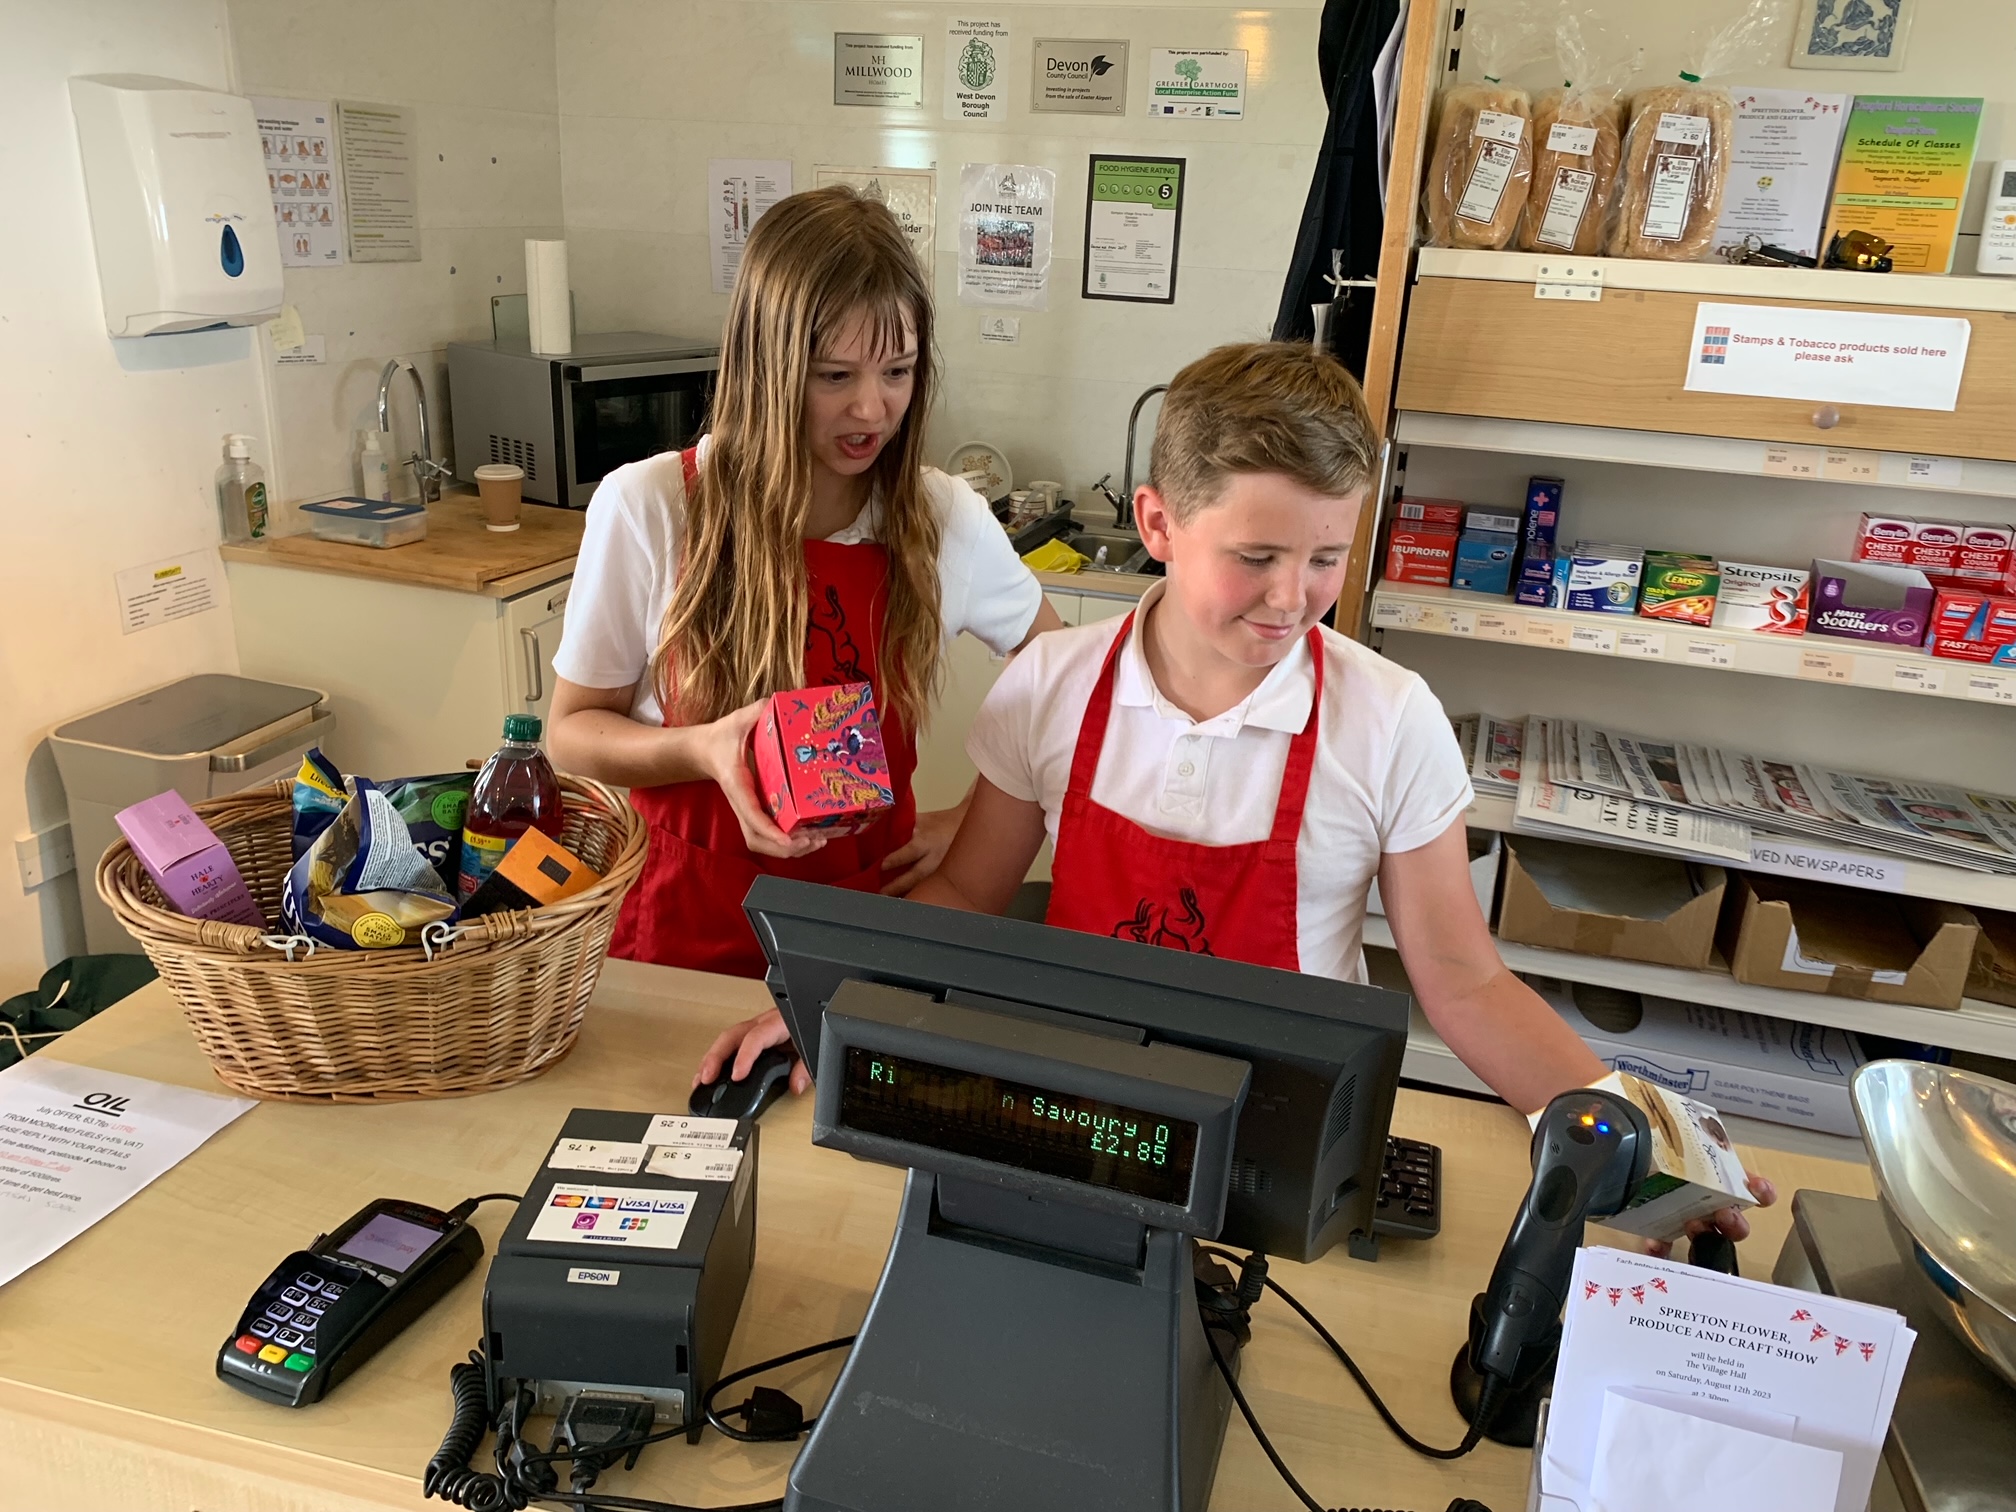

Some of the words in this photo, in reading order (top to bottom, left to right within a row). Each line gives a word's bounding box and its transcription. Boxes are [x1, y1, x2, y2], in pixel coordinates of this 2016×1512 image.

[970, 21, 989, 29] project
[973, 29, 994, 37] funding
[1047, 57, 1088, 72] Devon
[845, 66, 913, 78] MILLWOOD
[1046, 72, 1066, 80] County
[1067, 72, 1088, 80] Council
[1045, 86, 1065, 94] Investing
[1194, 81, 1238, 89] DARTMOOR
[956, 92, 973, 100] West
[1172, 89, 1201, 97] Enterprise
[962, 101, 989, 110] Borough
[963, 110, 988, 118] Council
[1857, 138, 1902, 147] Schedule
[1906, 139, 1919, 148] Of
[1924, 140, 1961, 149] Classes
[1494, 151, 1513, 161] Bakery
[1099, 164, 1119, 172] FOOD
[1120, 165, 1149, 174] HYGIENE
[1150, 166, 1175, 175] RATING
[1671, 164, 1691, 172] Bakery
[1570, 177, 1589, 187] Bakery
[1162, 185, 1170, 198] 5
[970, 203, 992, 213] JOIN
[995, 204, 1012, 215] THE
[1015, 205, 1043, 215] TEAM
[1732, 333, 1774, 346] Stamps
[1777, 337, 1785, 346] &
[1789, 337, 1837, 350] Tobacco
[1839, 342, 1890, 354] products
[1893, 345, 1918, 355] sold
[1921, 347, 1946, 358] here
[1794, 351, 1831, 363] please
[1834, 354, 1854, 363] ask
[1873, 526, 1909, 538] Benylin
[1920, 531, 1956, 544] Benylin
[1865, 542, 1909, 553] CHESTY
[1968, 536, 2004, 548] Benylin
[1392, 544, 1450, 558] IBUPROFEN
[1867, 550, 1903, 559] COUGHS
[1912, 547, 1957, 558] CHESTY
[1960, 551, 2005, 562] CHESTY
[1915, 554, 1951, 563] COUGHS
[1963, 559, 1999, 568] COUGHS
[1665, 575, 1703, 586] LEMSIP
[1724, 566, 1802, 584] Strepsils
[1723, 578, 1761, 589] Original
[1946, 602, 1976, 613] Rennie
[1833, 609, 1867, 619] HALLS
[1817, 610, 1889, 633] Soothers
[1940, 640, 1969, 650] FAST
[1663, 816, 1679, 838] kill
[1784, 852, 1885, 881] NEWSPAPERS
[190, 864, 214, 882] HALE
[191, 874, 224, 897] HEARTY
[1616, 1059, 1689, 1091] Worthminster
[1714, 1079, 1739, 1090] CLEAR
[83, 1092, 131, 1112] OIL
[870, 1061, 895, 1085] Ri
[1032, 1096, 1138, 1138] Savoury
[36, 1105, 52, 1116] July
[110, 1122, 137, 1134] LITRE
[659, 1120, 688, 1129] 0.25
[3, 1112, 29, 1124] FROM
[29, 1118, 76, 1135] MOORLAND
[75, 1127, 101, 1140] FUELS
[122, 1138, 144, 1150] VAT)
[0, 1124, 21, 1135] EASE
[21, 1128, 48, 1142] REPLY
[49, 1134, 72, 1147] WITH
[72, 1141, 96, 1152] YOUR
[96, 1146, 131, 1160] DETAILS
[568, 1144, 597, 1152] 4.75
[1091, 1131, 1167, 1166] £2.85
[3, 1138, 17, 1148] line
[49, 1149, 83, 1163] postcode
[84, 1155, 91, 1164] &
[90, 1156, 116, 1170] phone
[117, 1164, 127, 1172] no
[662, 1150, 692, 1160] 5.35
[3, 1179, 21, 1187] time
[43, 1188, 62, 1197] best
[625, 1200, 651, 1208] VISA
[659, 1202, 685, 1210] VISA
[1616, 1257, 1632, 1267] Each
[577, 1271, 610, 1282] EPSON
[295, 1315, 305, 1323] 8
[256, 1322, 270, 1330] MENU
[1659, 1306, 1728, 1329] SPREYTON
[1731, 1322, 1792, 1345] FLOWER,
[1629, 1316, 1692, 1337] PRODUCE
[1695, 1330, 1725, 1344] AND
[1728, 1336, 1773, 1355] CRAFT
[1776, 1348, 1819, 1366] SHOW
[1690, 1351, 1706, 1361] will
[1706, 1353, 1716, 1362] be
[1717, 1356, 1735, 1368] held
[1736, 1360, 1745, 1369] in
[1685, 1360, 1700, 1371] The
[1701, 1362, 1728, 1377] Village
[1730, 1368, 1747, 1380] Hall
[1655, 1369, 1666, 1377] on
[1667, 1371, 1702, 1385] Saturday,
[1703, 1377, 1732, 1392] August
[1733, 1384, 1751, 1395] 12th
[1752, 1389, 1772, 1400] 2023
